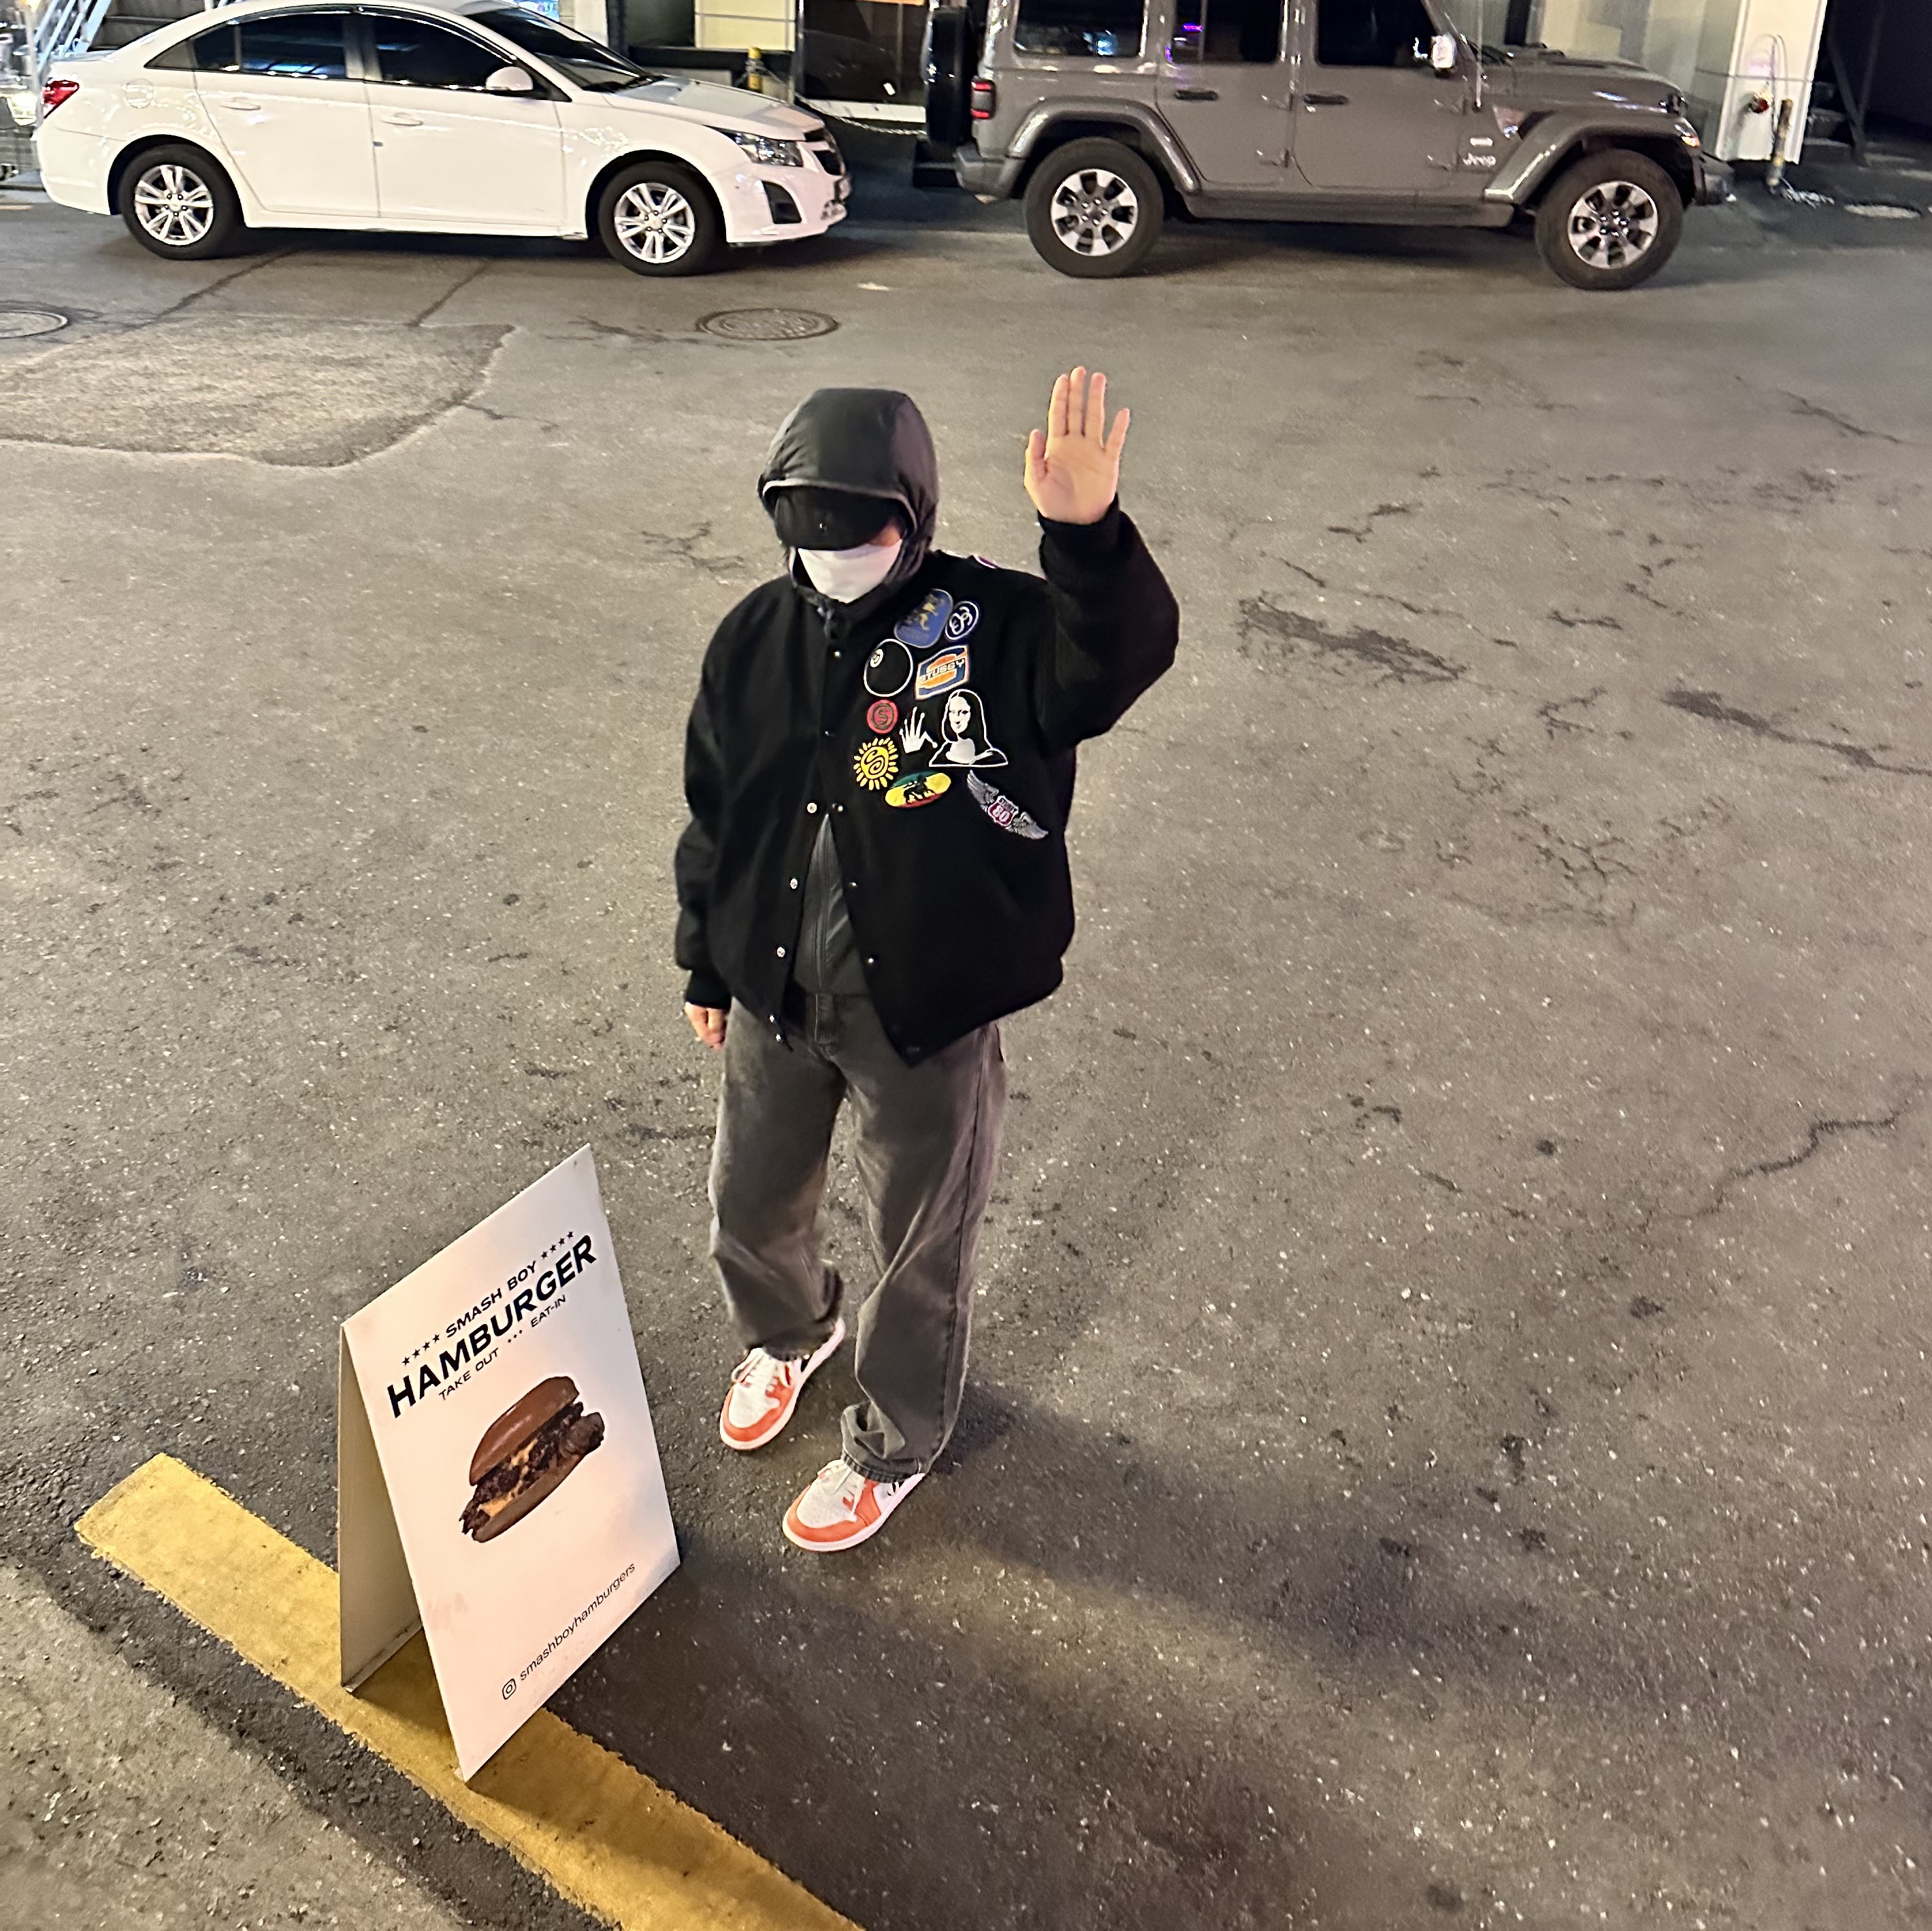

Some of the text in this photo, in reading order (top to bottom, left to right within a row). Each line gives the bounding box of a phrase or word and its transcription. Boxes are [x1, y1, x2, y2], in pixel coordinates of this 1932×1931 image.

[387, 1234, 597, 1419] HAMBURGER
[438, 1294, 566, 1401] TAKE OUT EAT-IN
[445, 1260, 537, 1338] SMASH BOY
[520, 1563, 636, 1681] smashboyhamburgers
